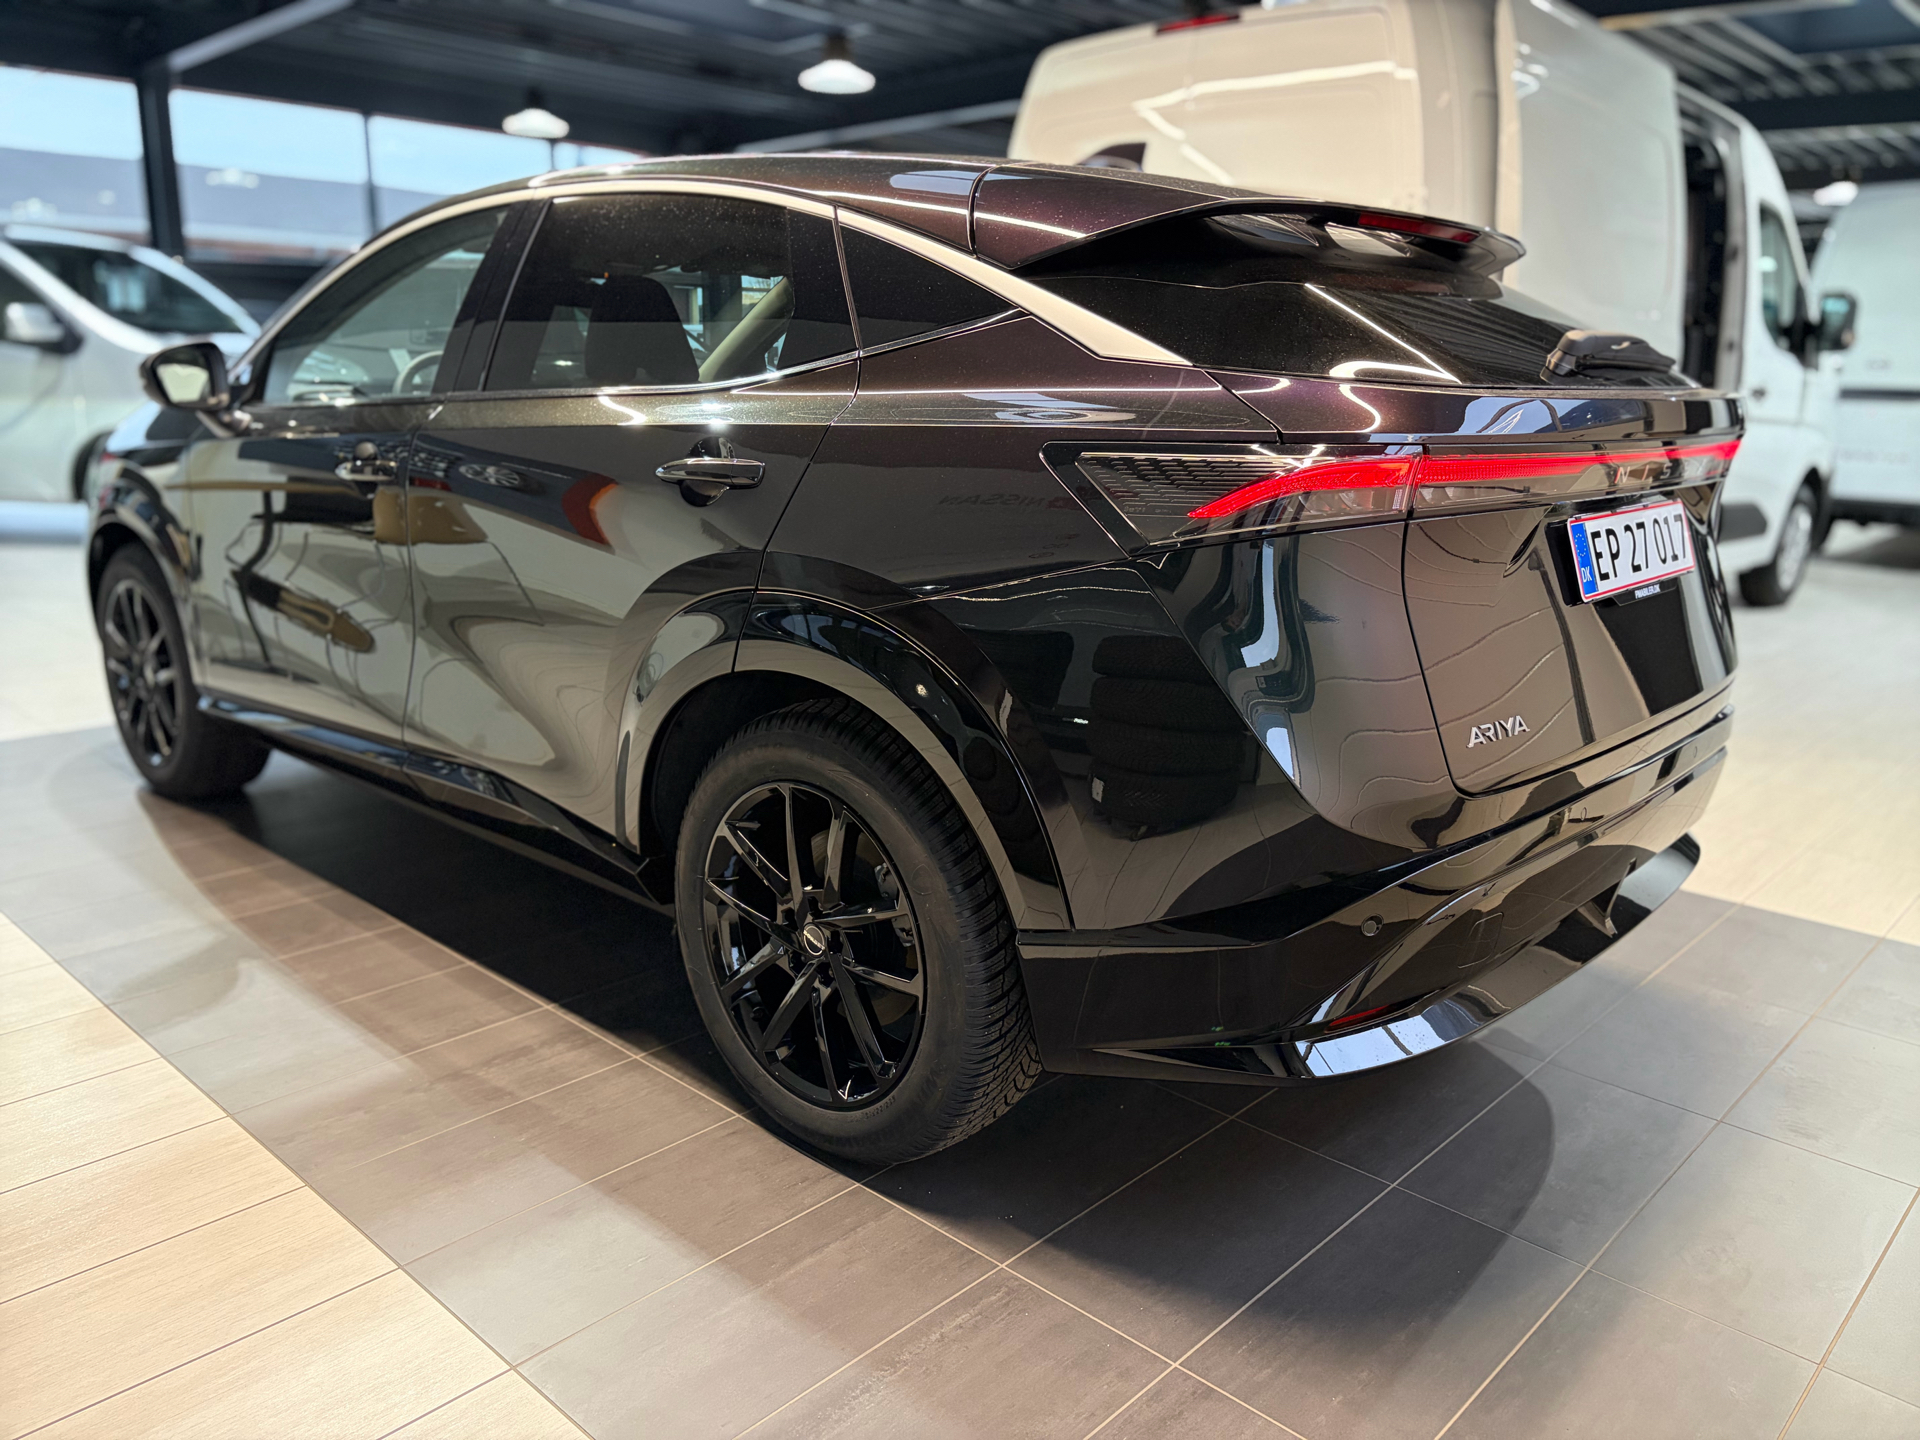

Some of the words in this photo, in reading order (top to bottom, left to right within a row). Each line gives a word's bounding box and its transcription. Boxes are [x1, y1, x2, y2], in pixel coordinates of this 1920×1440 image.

[1590, 528, 1621, 582] EP
[1623, 521, 1649, 574] 27
[1652, 513, 1686, 565] 017
[1580, 567, 1593, 583] DK
[1466, 715, 1530, 748] ARIYA
